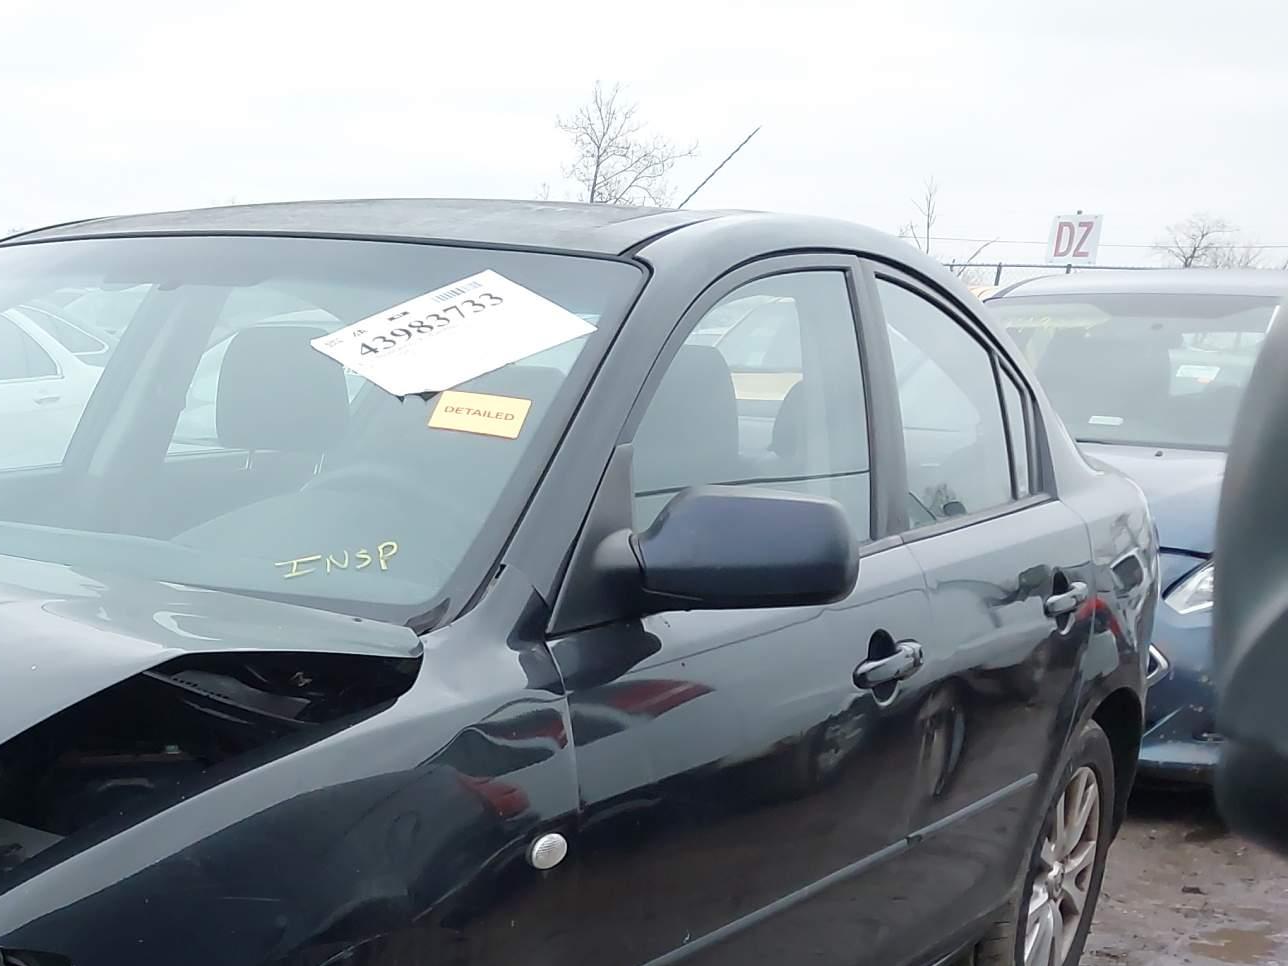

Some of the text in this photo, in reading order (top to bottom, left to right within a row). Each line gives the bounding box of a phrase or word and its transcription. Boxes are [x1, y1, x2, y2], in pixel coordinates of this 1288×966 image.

[1053, 221, 1094, 258] DZ
[359, 292, 504, 356] 43983733
[444, 405, 515, 421] DETAILED
[273, 541, 398, 578] INSP
